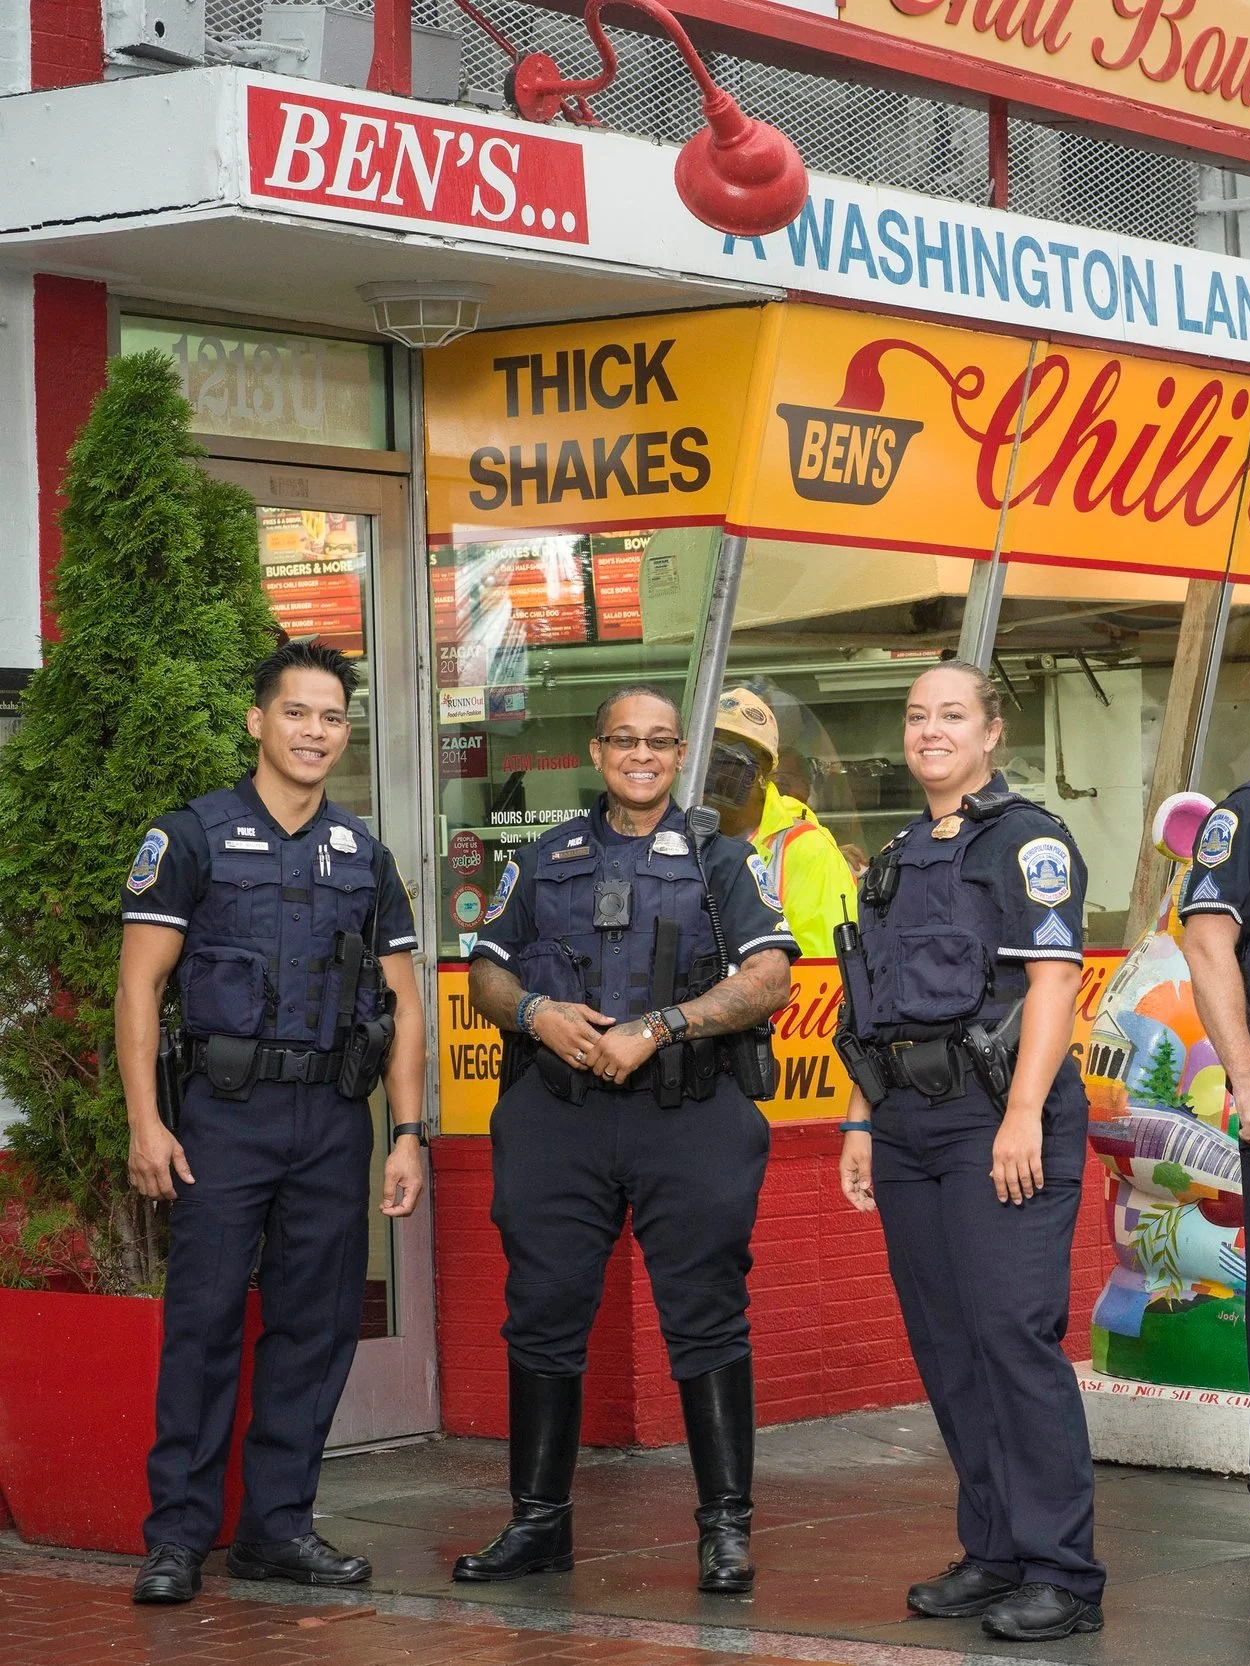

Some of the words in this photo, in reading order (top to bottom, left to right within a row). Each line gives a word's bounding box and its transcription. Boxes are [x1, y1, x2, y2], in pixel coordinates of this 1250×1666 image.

[787, 195, 1158, 327] WASHINGTON
[493, 340, 677, 419] THICK
[799, 423, 899, 490] BEN'S
[469, 427, 711, 512] SHAKES
[624, 537, 651, 551] BOW
[266, 562, 312, 577] BURGERS
[313, 563, 322, 574] &
[322, 560, 354, 573] MORE
[440, 645, 481, 660] ZAGAT
[441, 735, 483, 750] ZAGAT
[442, 750, 468, 764] 2014
[502, 752, 533, 773] ATM
[536, 752, 580, 772] inside
[491, 811, 522, 825] HOURS
[524, 810, 537, 823] OF
[237, 826, 256, 837] POLICE
[500, 831, 522, 844] Sun:
[494, 849, 516, 862] M-T
[771, 982, 844, 1040] hil
[449, 1043, 501, 1080] VEGG
[775, 1055, 836, 1100] WL
[1217, 1311, 1240, 1328] Jody
[1199, 1391, 1220, 1405] OR
